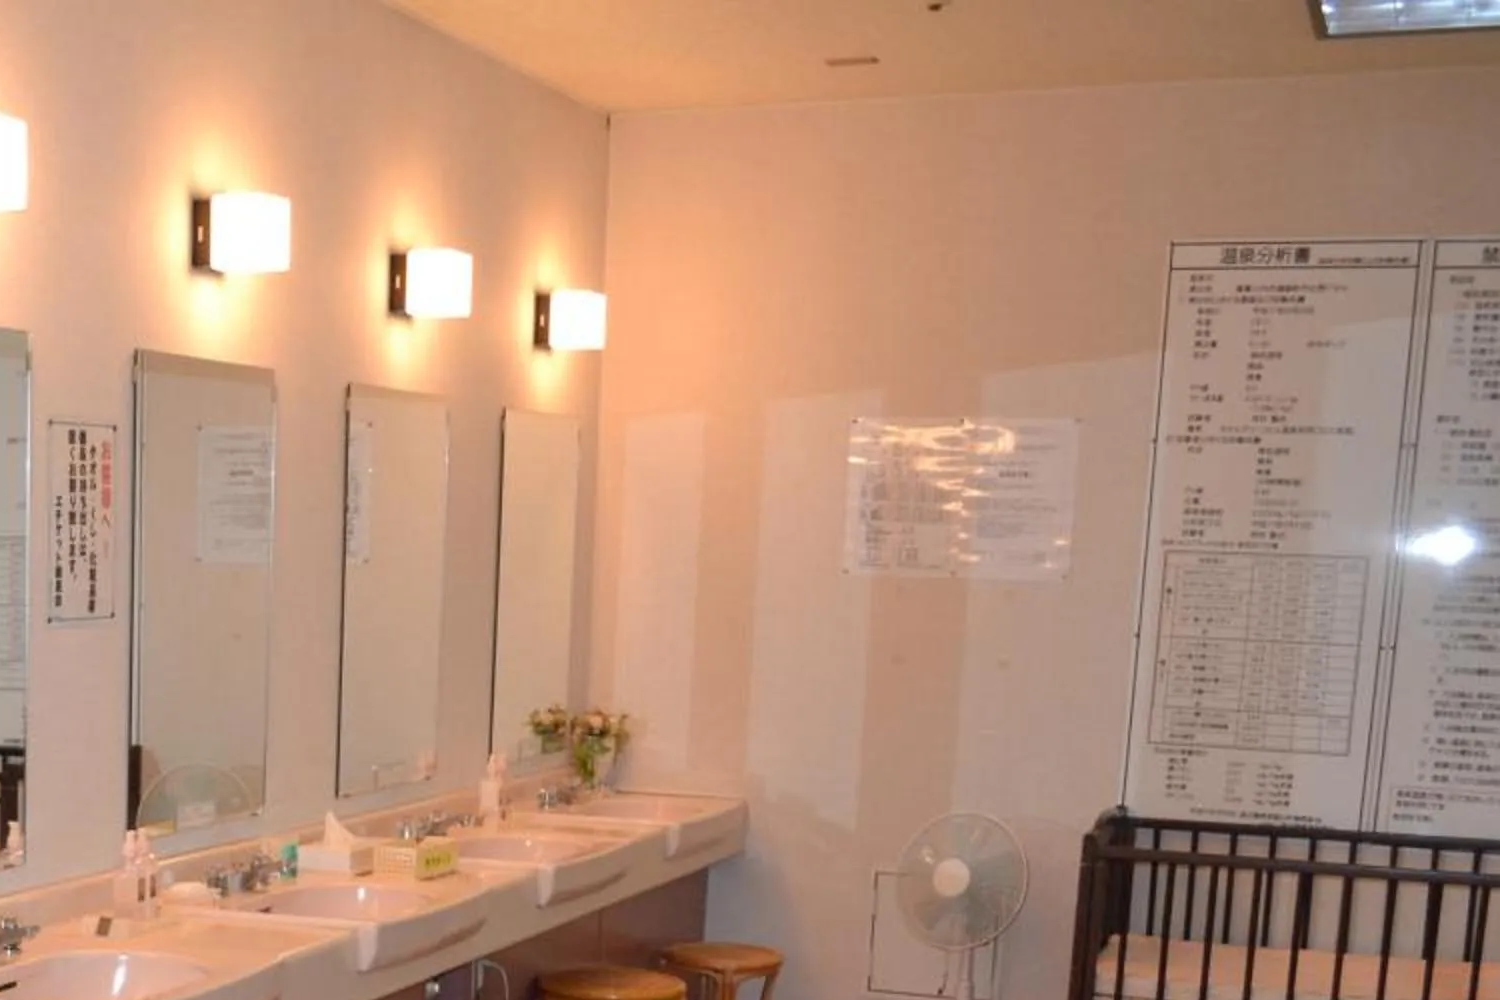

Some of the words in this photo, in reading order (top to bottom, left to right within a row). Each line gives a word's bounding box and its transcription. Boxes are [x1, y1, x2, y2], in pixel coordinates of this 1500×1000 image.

[1220, 246, 1311, 265] 温泉分析書
